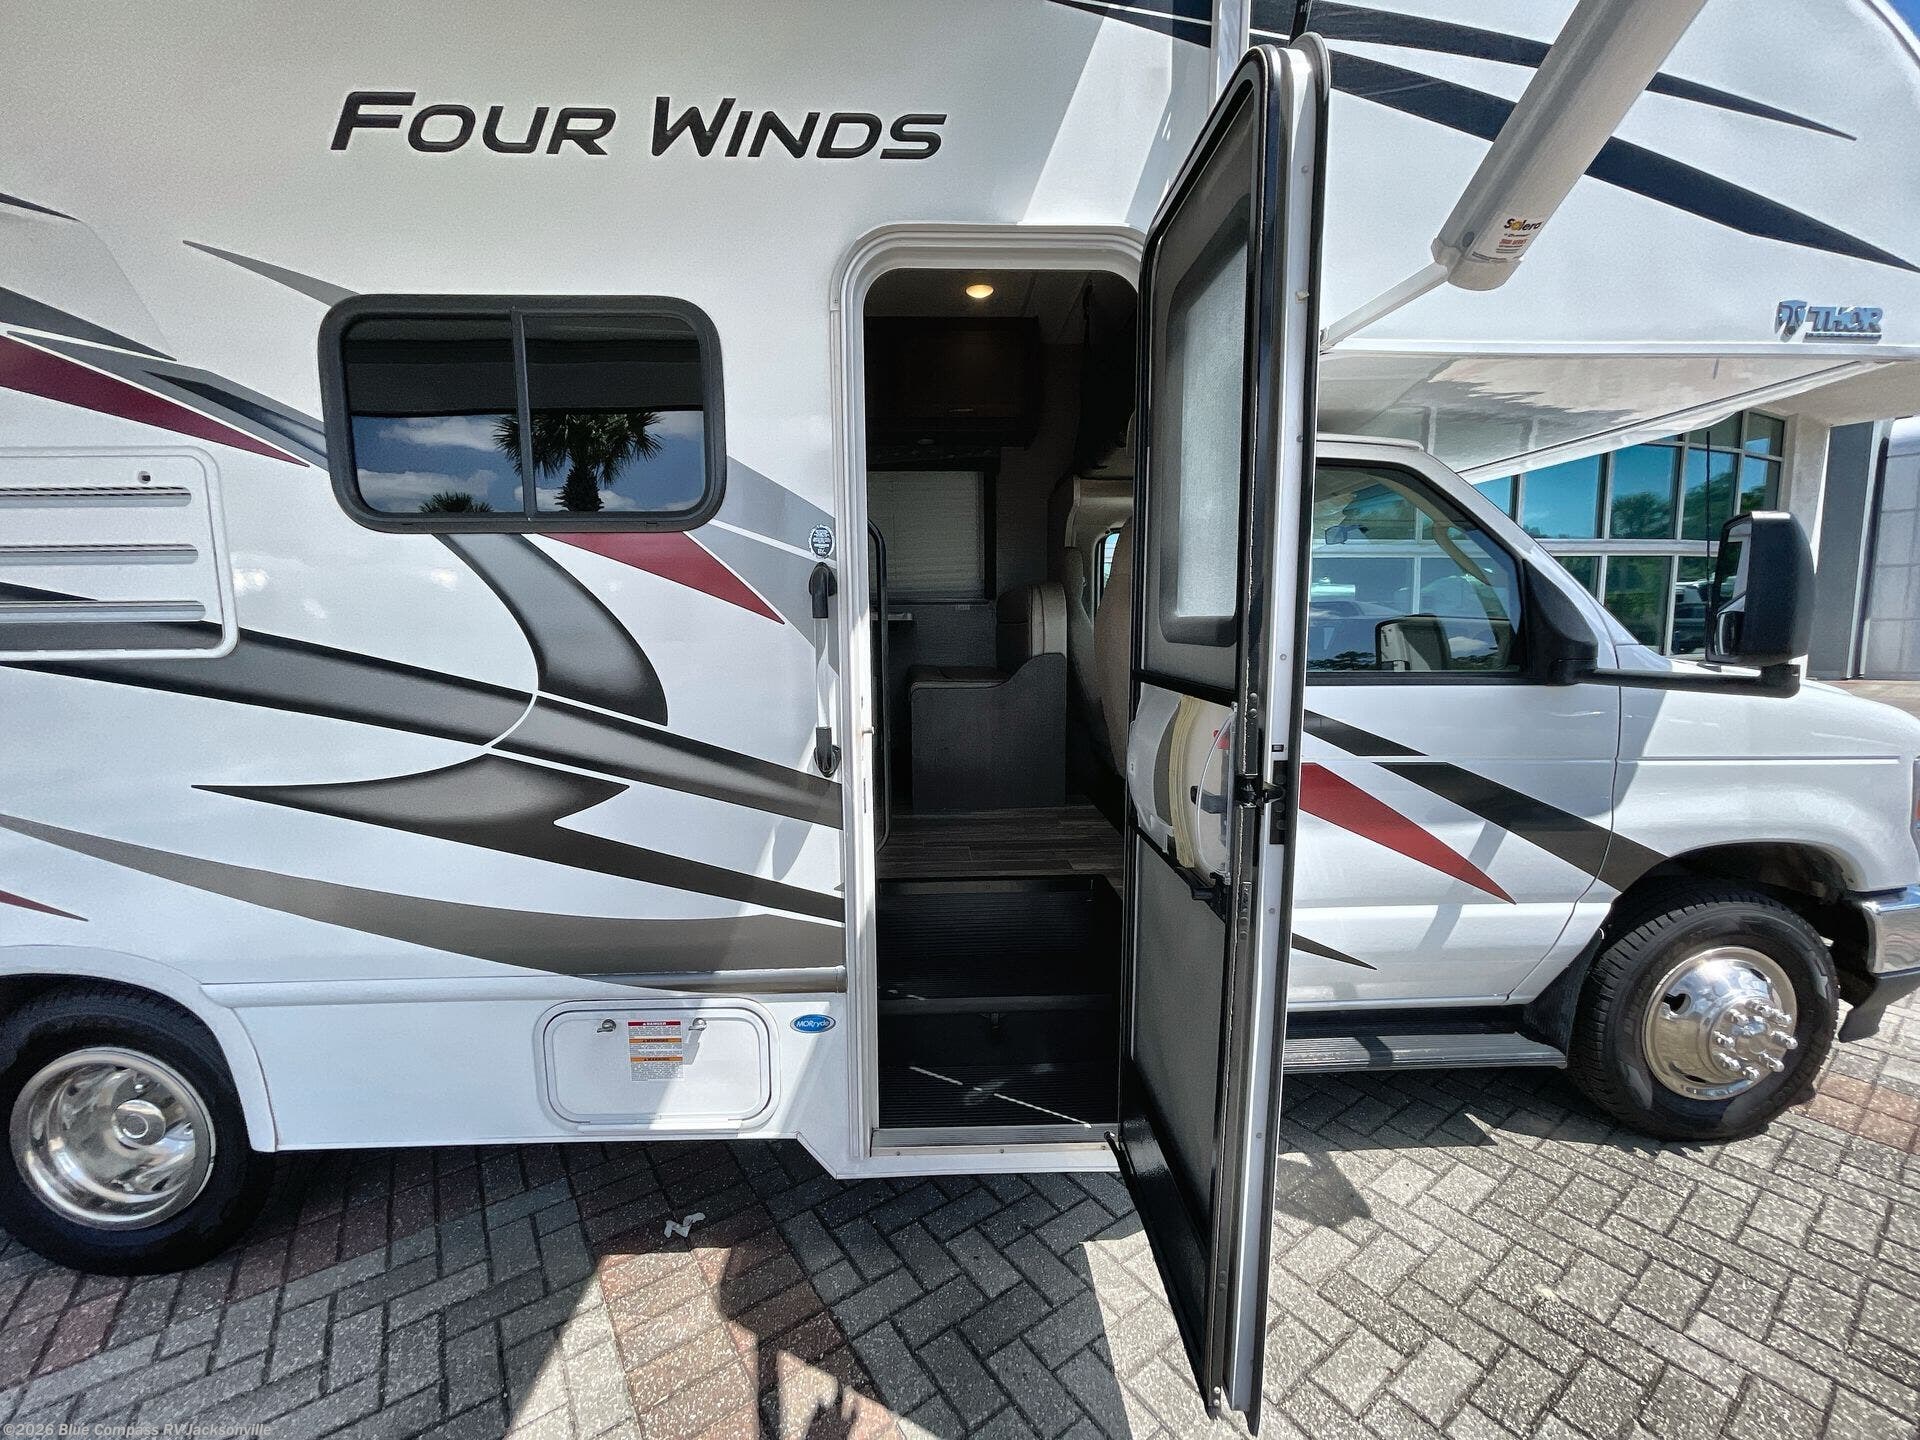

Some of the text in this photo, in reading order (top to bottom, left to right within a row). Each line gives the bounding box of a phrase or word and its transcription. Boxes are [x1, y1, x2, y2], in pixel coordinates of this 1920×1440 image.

[331, 91, 947, 160] FOUR WINDS
[1504, 218, 1543, 231] Solera
[1808, 306, 1883, 333] THOR
